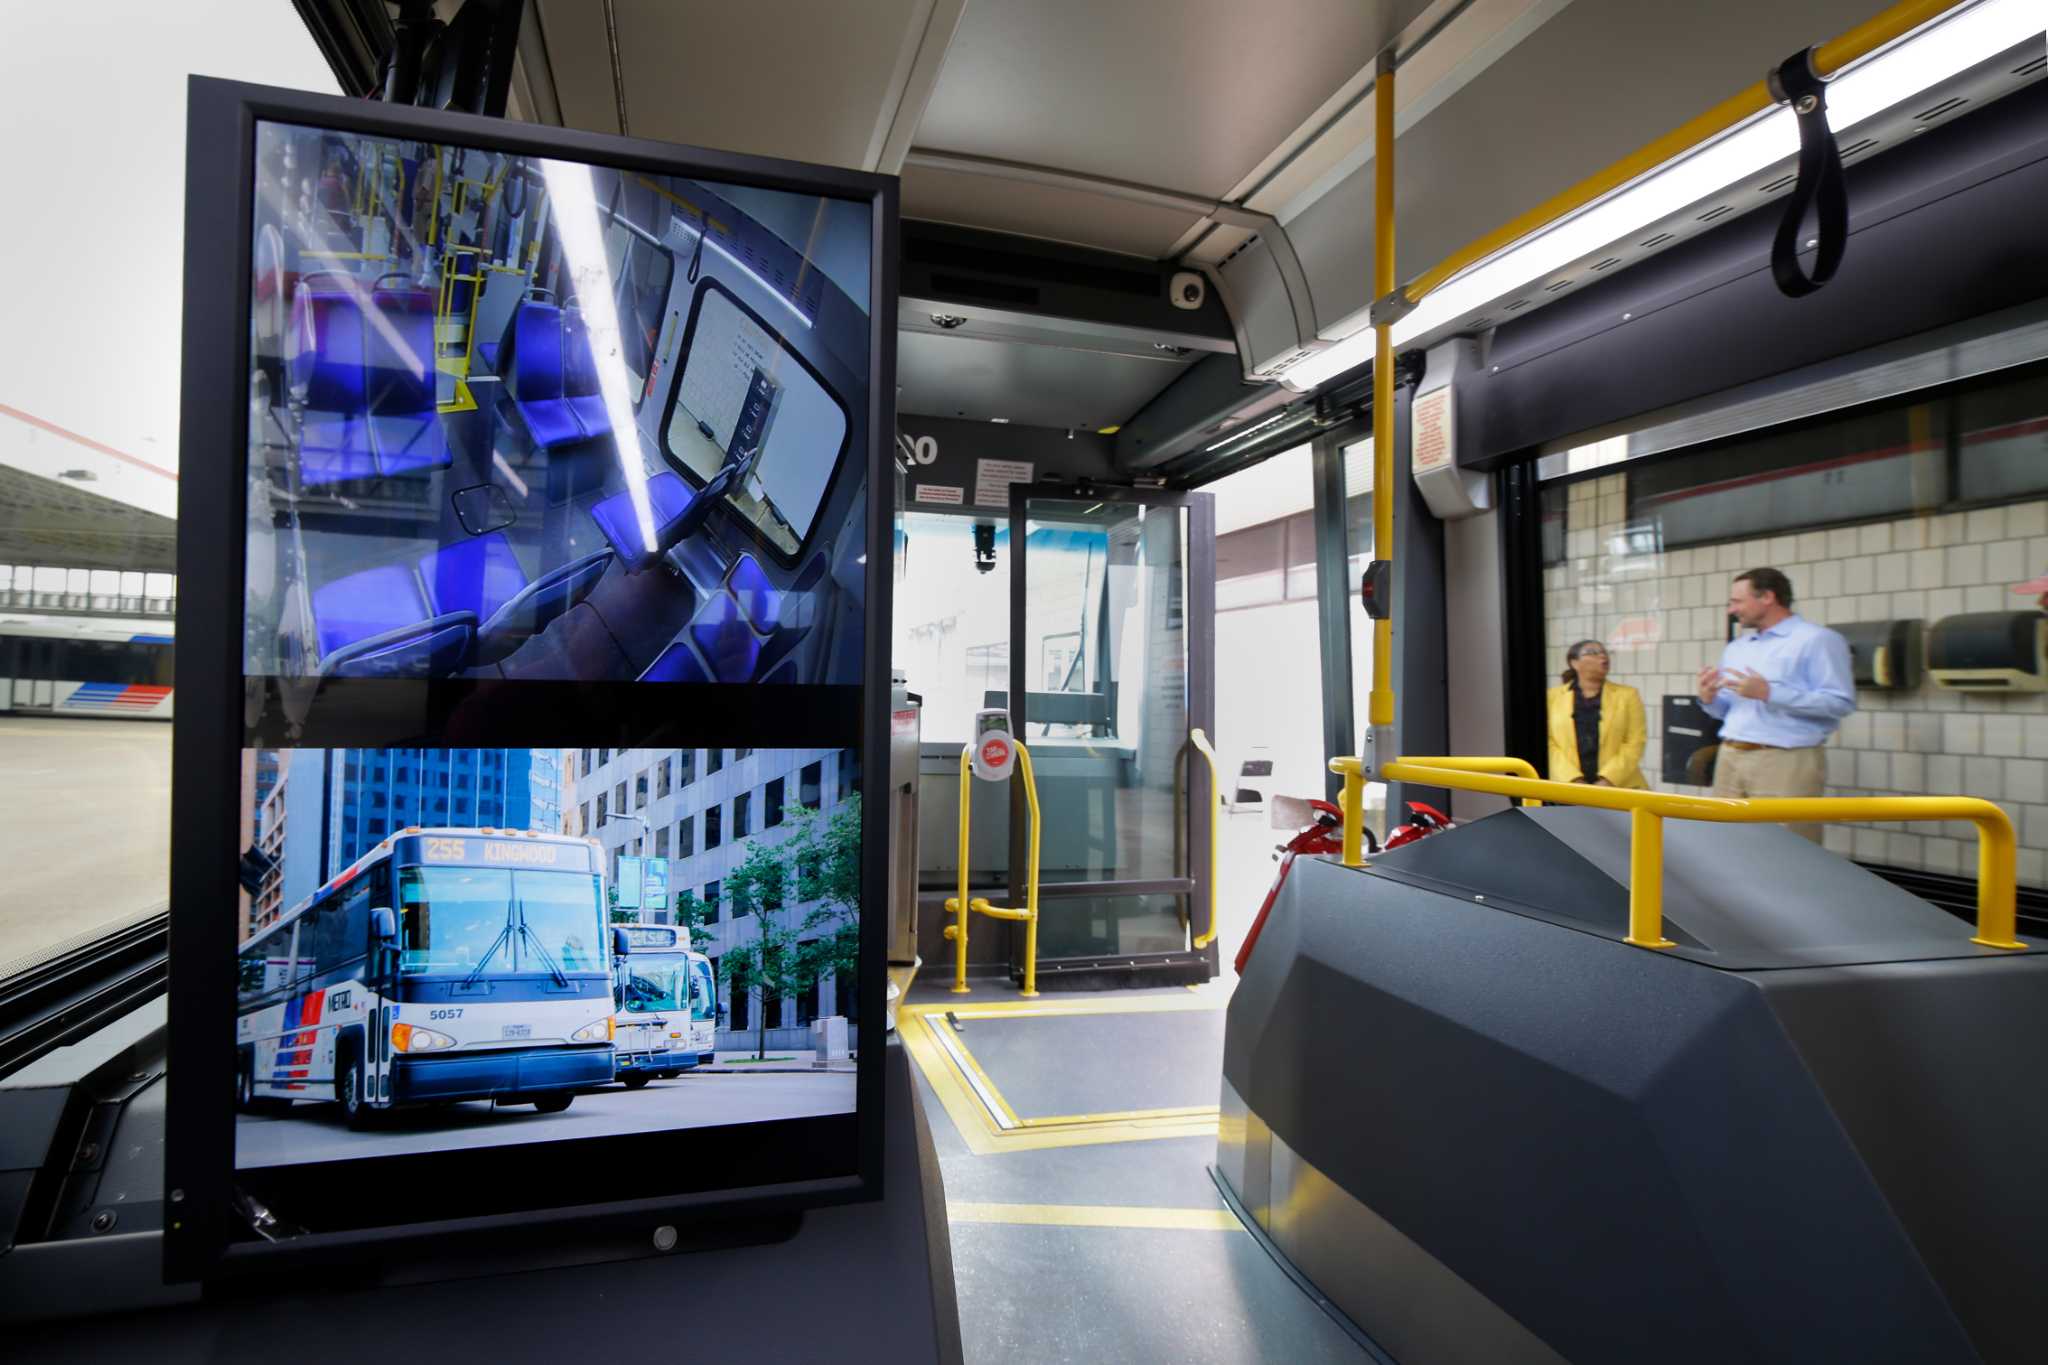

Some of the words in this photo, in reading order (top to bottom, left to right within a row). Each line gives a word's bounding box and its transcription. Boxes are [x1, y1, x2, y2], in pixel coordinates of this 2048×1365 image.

[426, 839, 465, 861] 255
[484, 841, 557, 864] KINGWOOD
[429, 1008, 464, 1020] 5057
